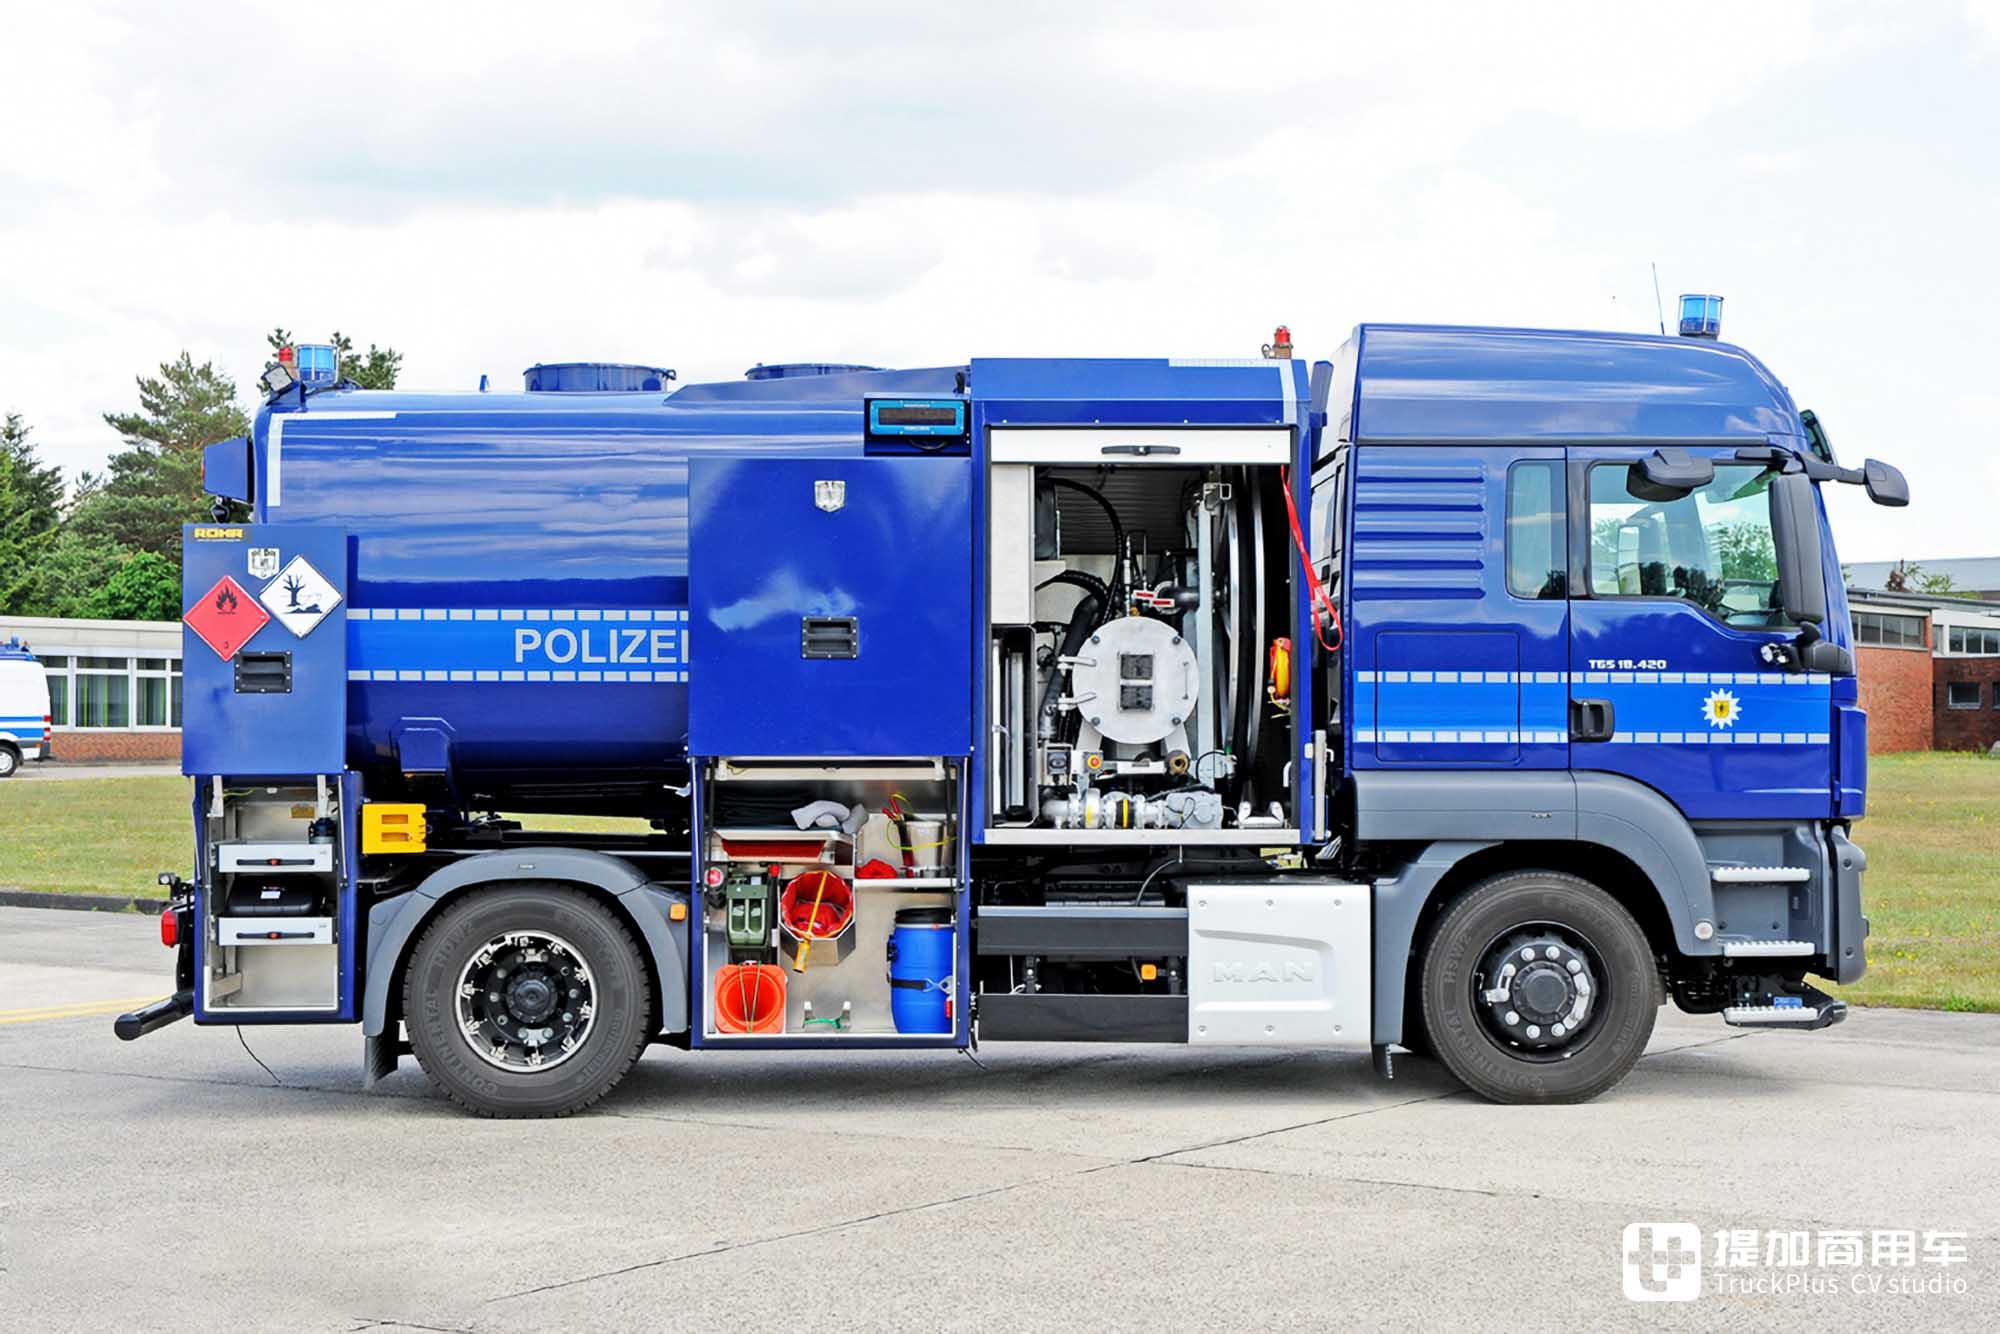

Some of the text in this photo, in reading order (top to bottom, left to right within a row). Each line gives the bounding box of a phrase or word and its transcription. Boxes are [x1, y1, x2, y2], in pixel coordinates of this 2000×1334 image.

[515, 628, 689, 664] POLIZEI
[1588, 659, 1667, 670] TGS 18.420
[1212, 960, 1313, 983] MAN
